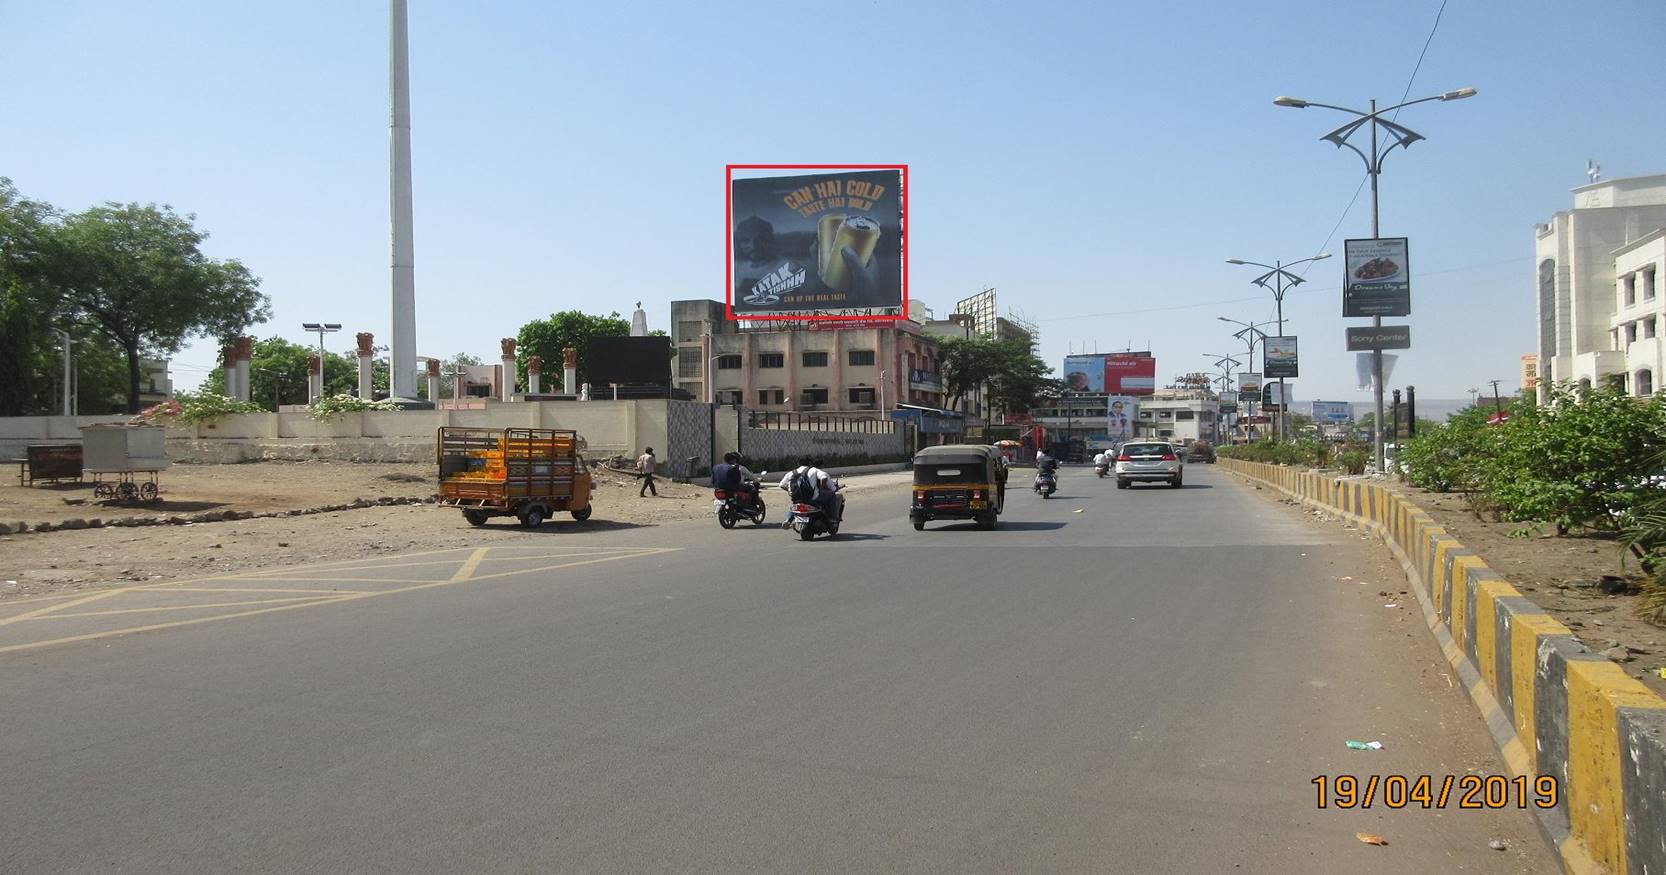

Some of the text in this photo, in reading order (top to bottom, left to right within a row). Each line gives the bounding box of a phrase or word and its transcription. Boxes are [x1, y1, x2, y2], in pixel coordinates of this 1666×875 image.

[784, 180, 885, 210] CAN HAI COLD
[799, 200, 826, 218] TASTE
[827, 197, 845, 209] HAI
[752, 262, 793, 296] KATAK
[1351, 334, 1407, 343] Sony Center
